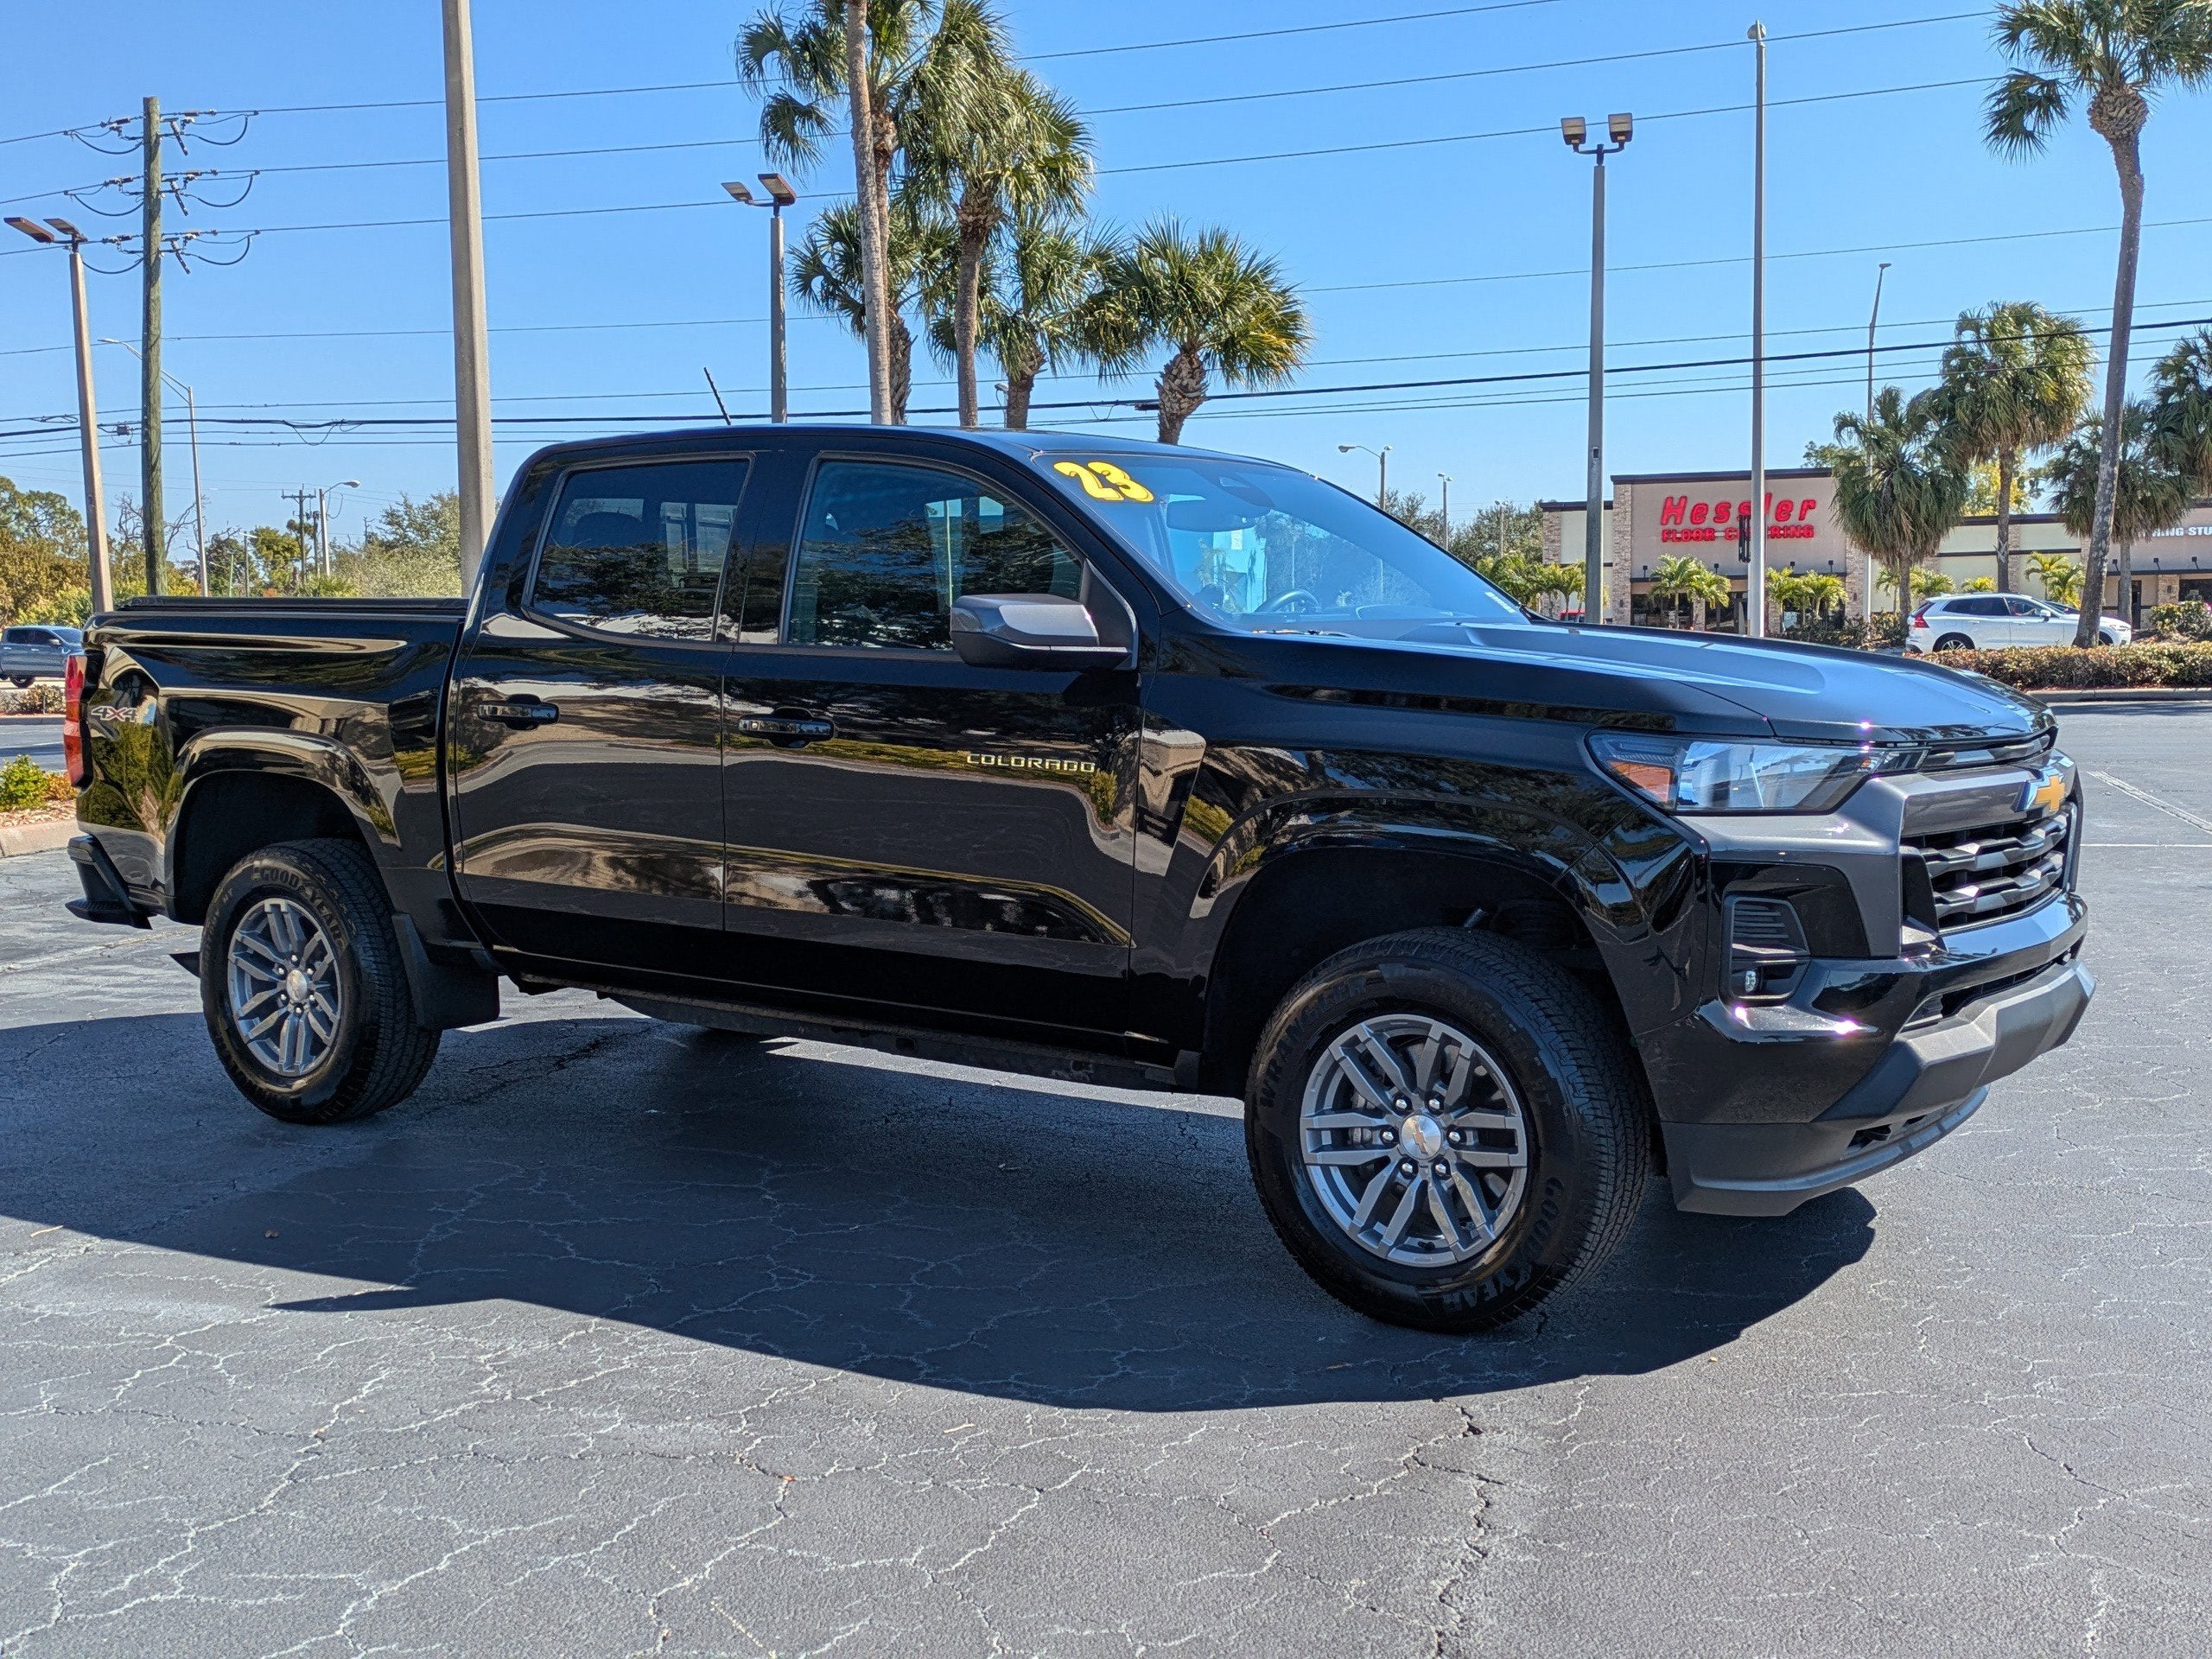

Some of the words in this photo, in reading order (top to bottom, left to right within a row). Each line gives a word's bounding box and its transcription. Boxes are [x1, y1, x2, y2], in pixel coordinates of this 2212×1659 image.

[1053, 461, 1154, 502] 23
[1662, 528, 1716, 543] FLOOR
[1725, 525, 1815, 541] CRING
[967, 753, 1096, 773] COLORADO
